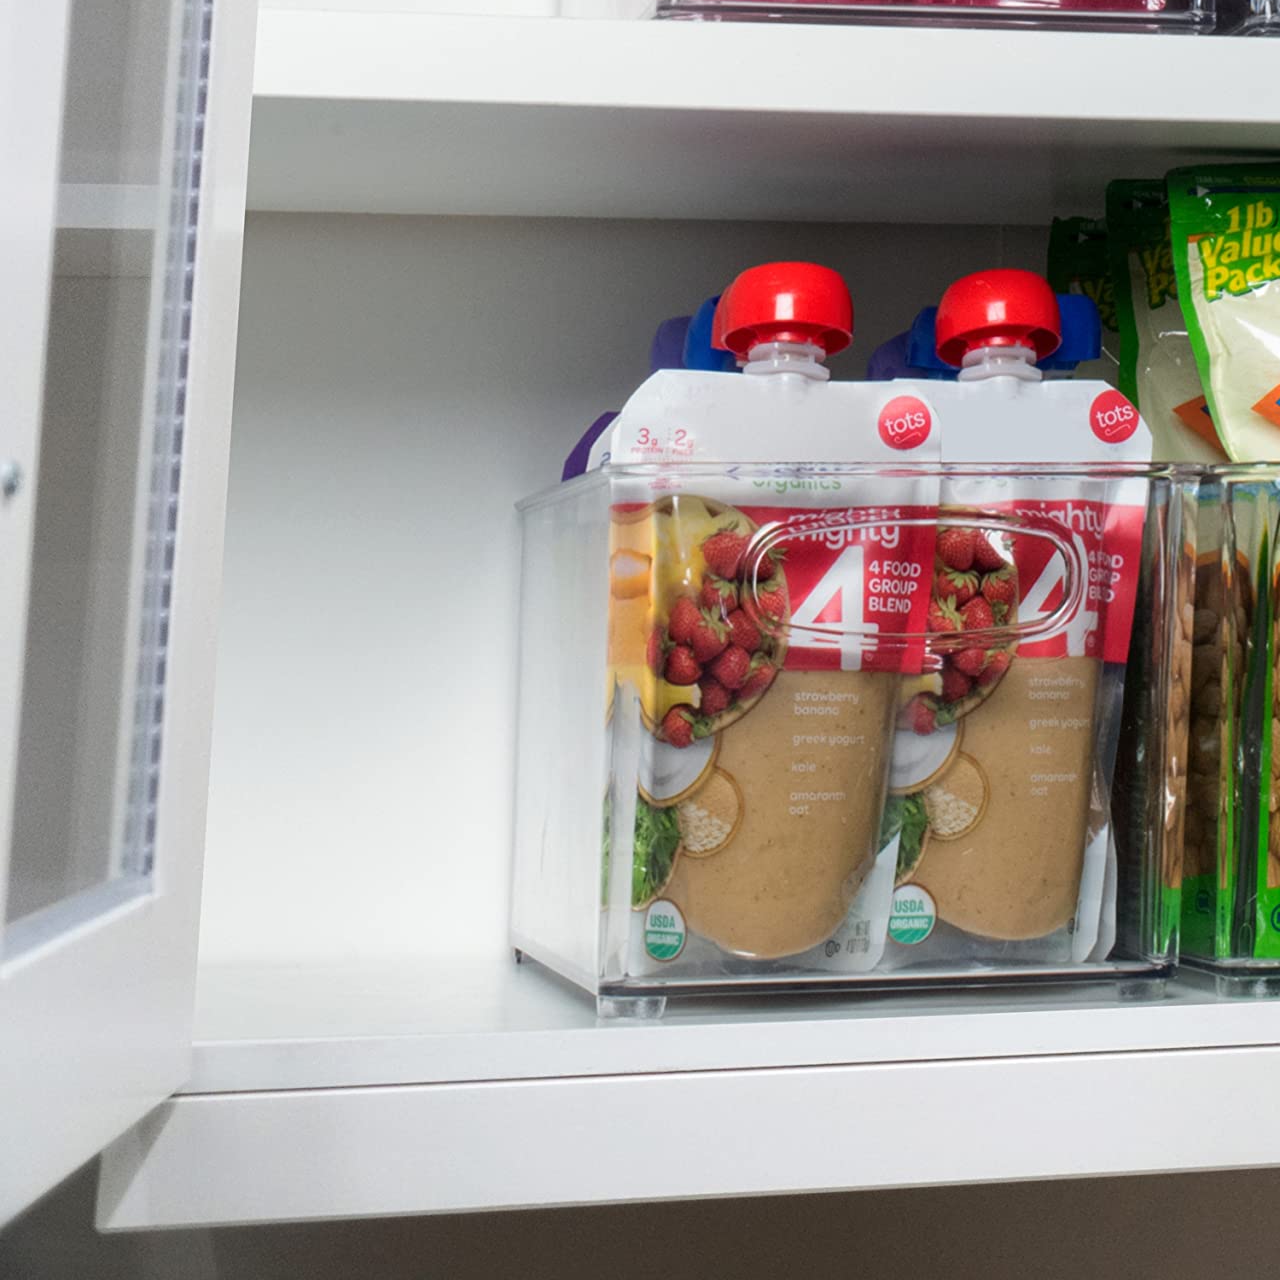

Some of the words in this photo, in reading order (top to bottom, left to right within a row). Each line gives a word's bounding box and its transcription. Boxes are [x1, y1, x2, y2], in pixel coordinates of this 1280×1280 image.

[885, 411, 927, 436] tots
[1095, 404, 1135, 429] tots
[868, 559, 881, 575] 4
[882, 560, 922, 578] FOOD
[868, 577, 918, 595] GROUP
[1088, 586, 1116, 603] BLD
[788, 545, 880, 671] 4
[868, 596, 912, 614] BLEND
[794, 691, 860, 705] strawberry
[793, 704, 840, 716] banana
[791, 734, 827, 747] greek
[828, 734, 865, 747] yogurt
[791, 760, 817, 773] kale
[789, 791, 848, 801] amaranth
[788, 804, 810, 816] oat
[893, 898, 925, 914] USDA
[649, 914, 677, 930] USDA
[889, 916, 930, 930] ORGANIC
[646, 932, 680, 946] ORGANIC
